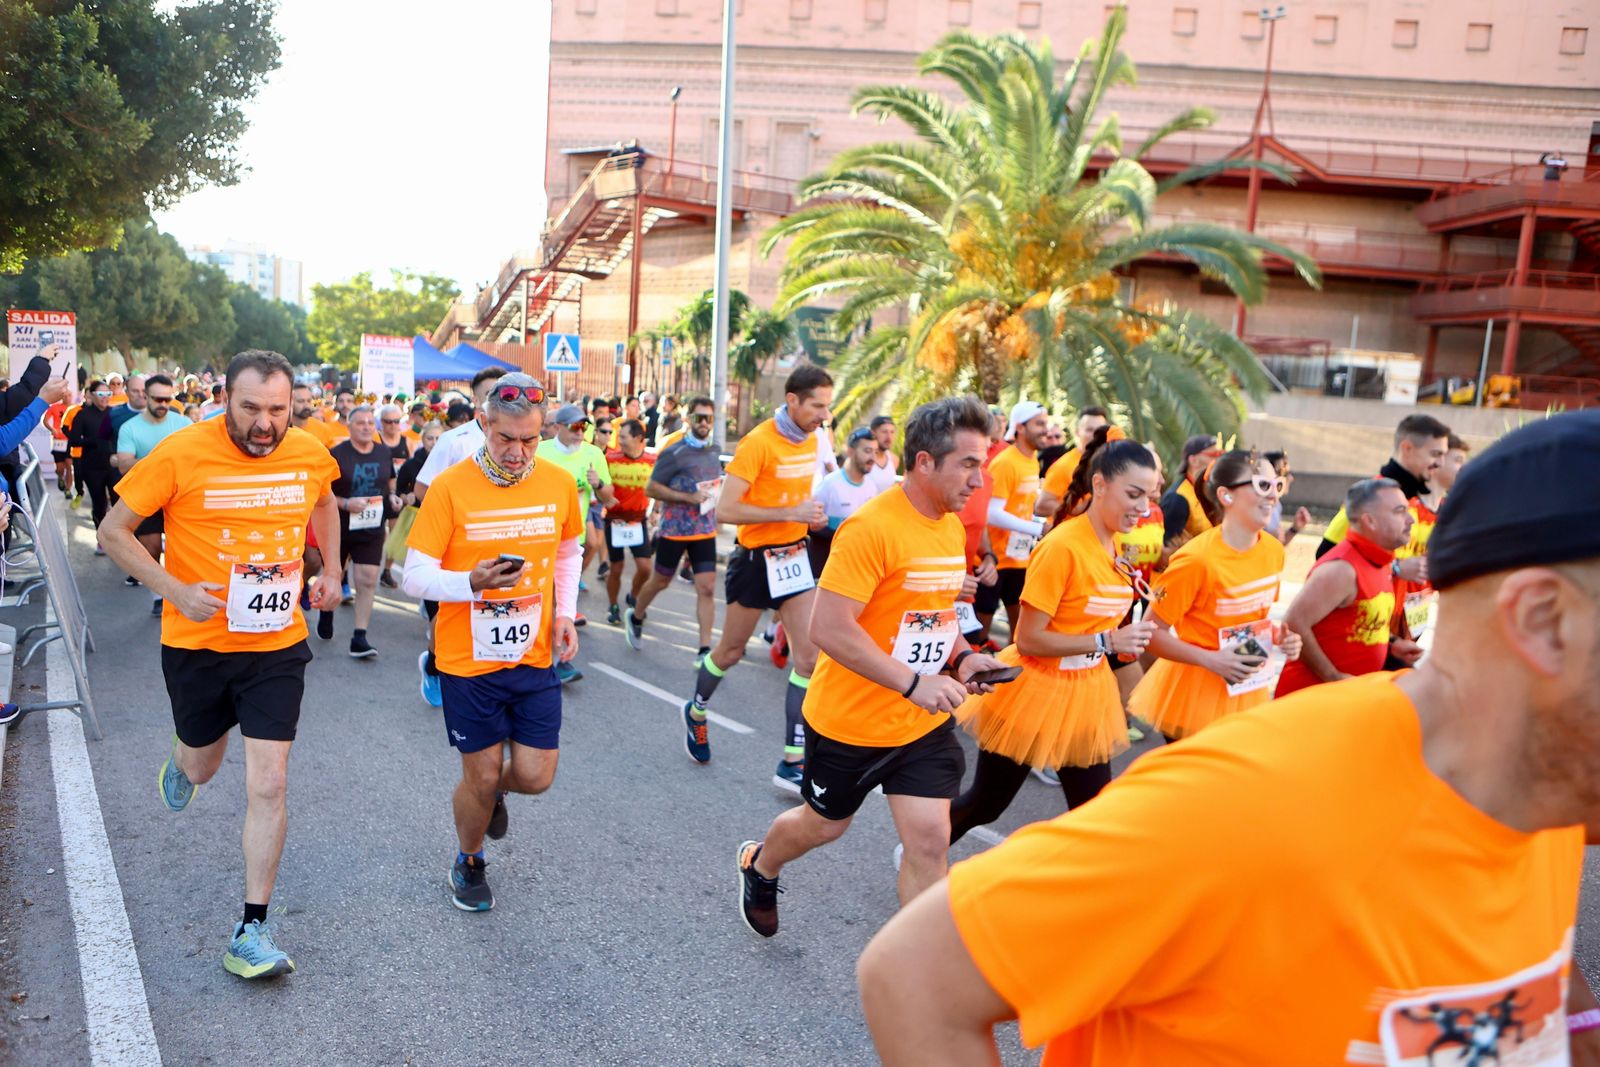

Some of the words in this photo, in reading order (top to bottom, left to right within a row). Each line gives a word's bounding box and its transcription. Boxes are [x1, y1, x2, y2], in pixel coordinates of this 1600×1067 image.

[11, 312, 72, 324] SALIDA
[14, 326, 33, 334] XII
[776, 563, 801, 581] 110
[248, 591, 291, 613] 448
[491, 624, 530, 644] 149
[908, 642, 945, 663] 315
